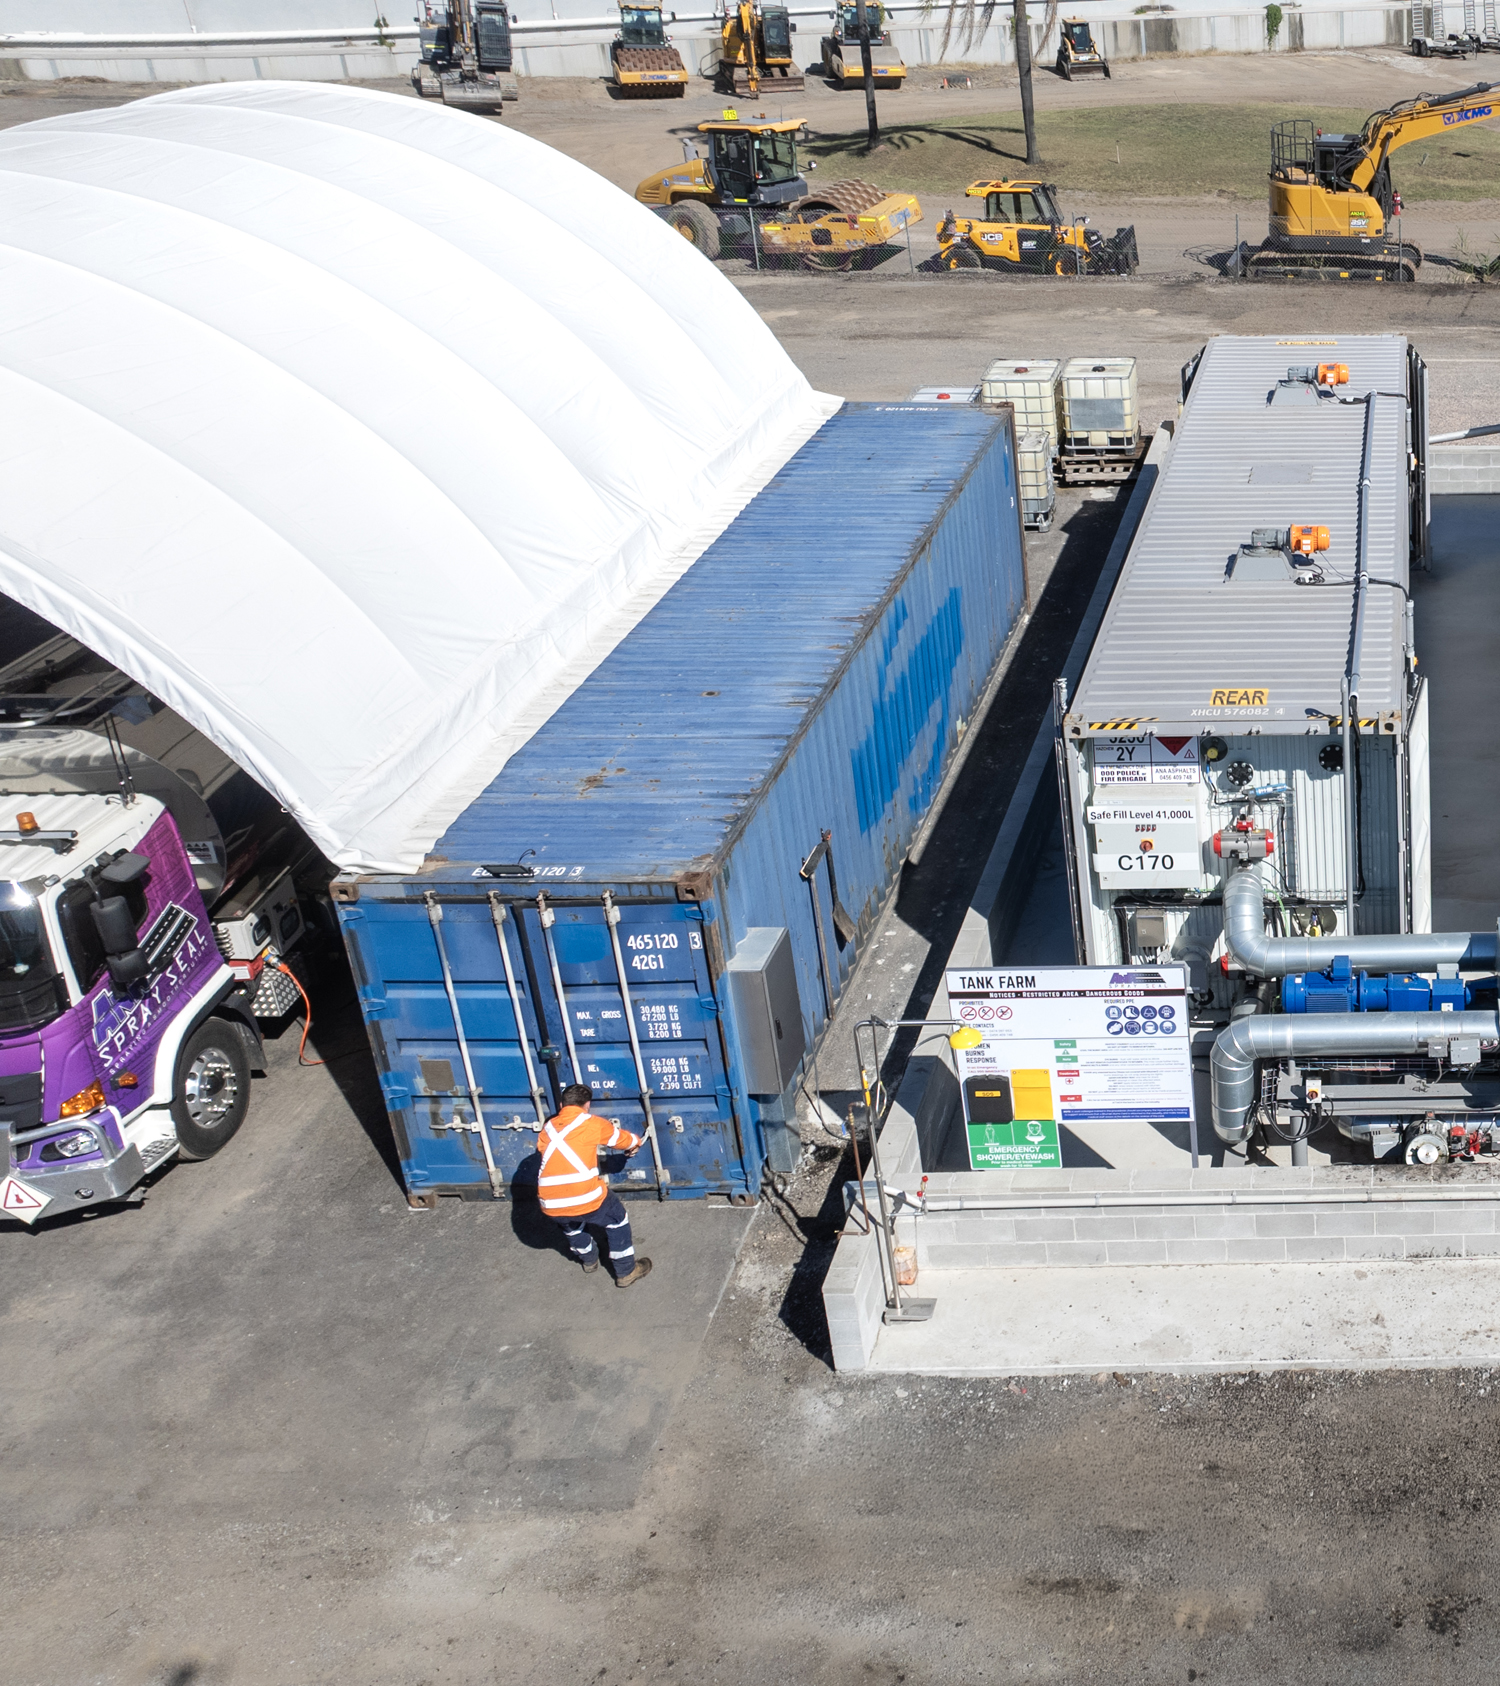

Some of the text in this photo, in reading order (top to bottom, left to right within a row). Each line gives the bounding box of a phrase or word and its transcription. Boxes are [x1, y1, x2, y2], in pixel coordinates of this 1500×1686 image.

[1456, 106, 1492, 122] XCMG
[1213, 690, 1264, 705] REAR
[1117, 747, 1135, 761] 2Y
[1090, 811, 1111, 820] Safe
[1114, 811, 1127, 819] Fill
[1156, 810, 1193, 819] 41,000L
[1118, 855, 1174, 870] C170
[627, 932, 701, 949] 465120 3
[632, 954, 664, 970] 42G1
[960, 976, 1036, 989] TANK FARM
[99, 930, 205, 1067] SPRAY SEAL
[601, 1010, 621, 1019] GROSS
